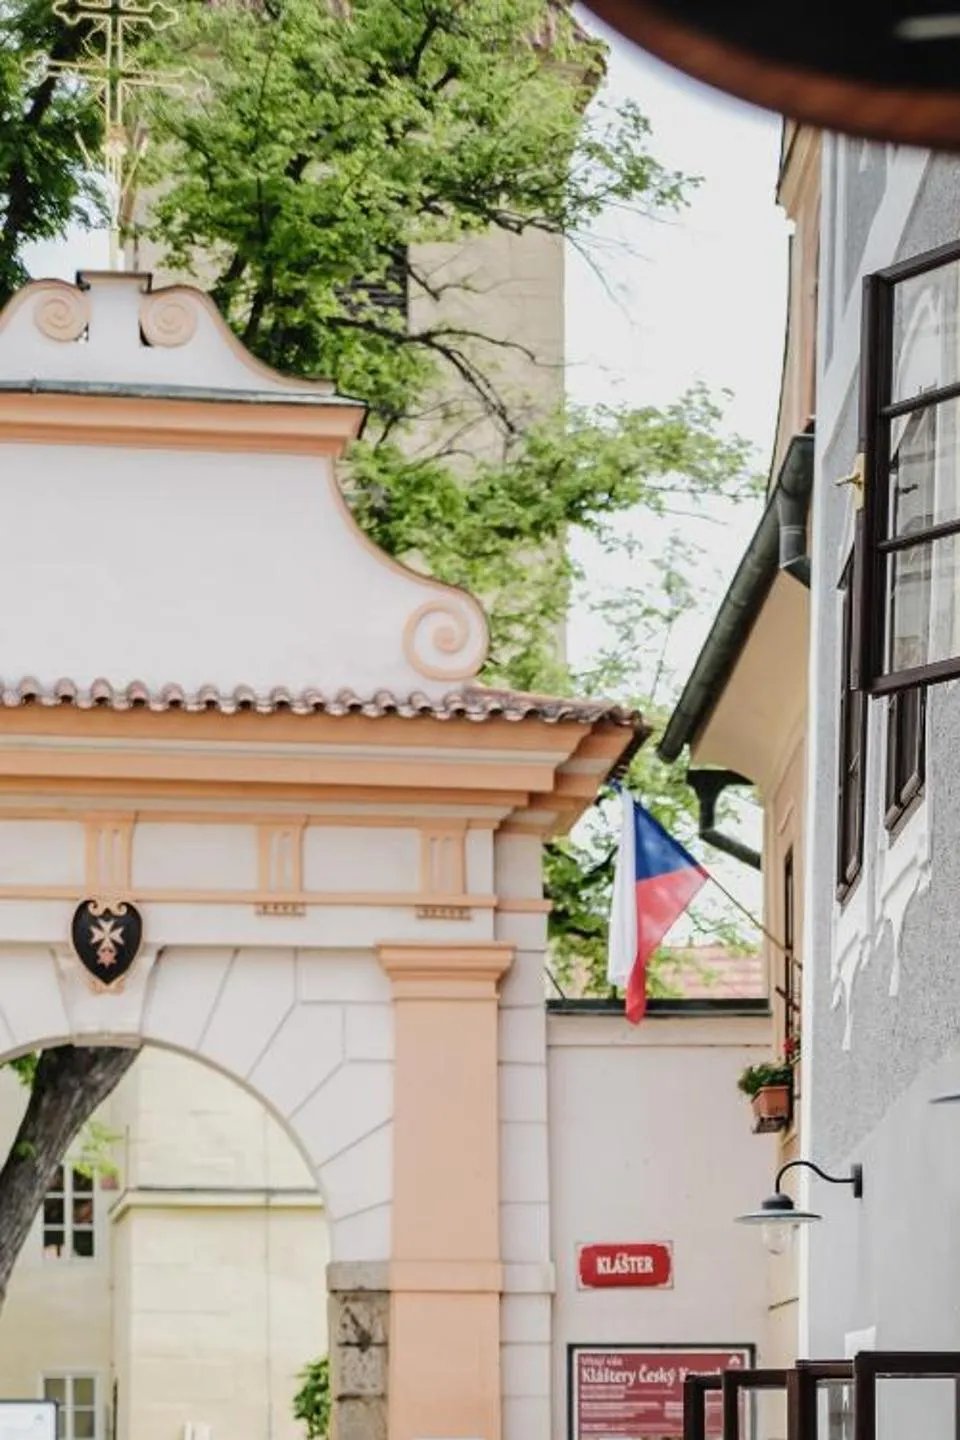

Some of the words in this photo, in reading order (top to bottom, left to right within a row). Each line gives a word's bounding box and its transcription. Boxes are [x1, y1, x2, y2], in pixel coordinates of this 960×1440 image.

[596, 1252, 654, 1274] KLÁŠTER
[581, 1366, 636, 1387] Kláštery
[638, 1363, 676, 1387] Český
